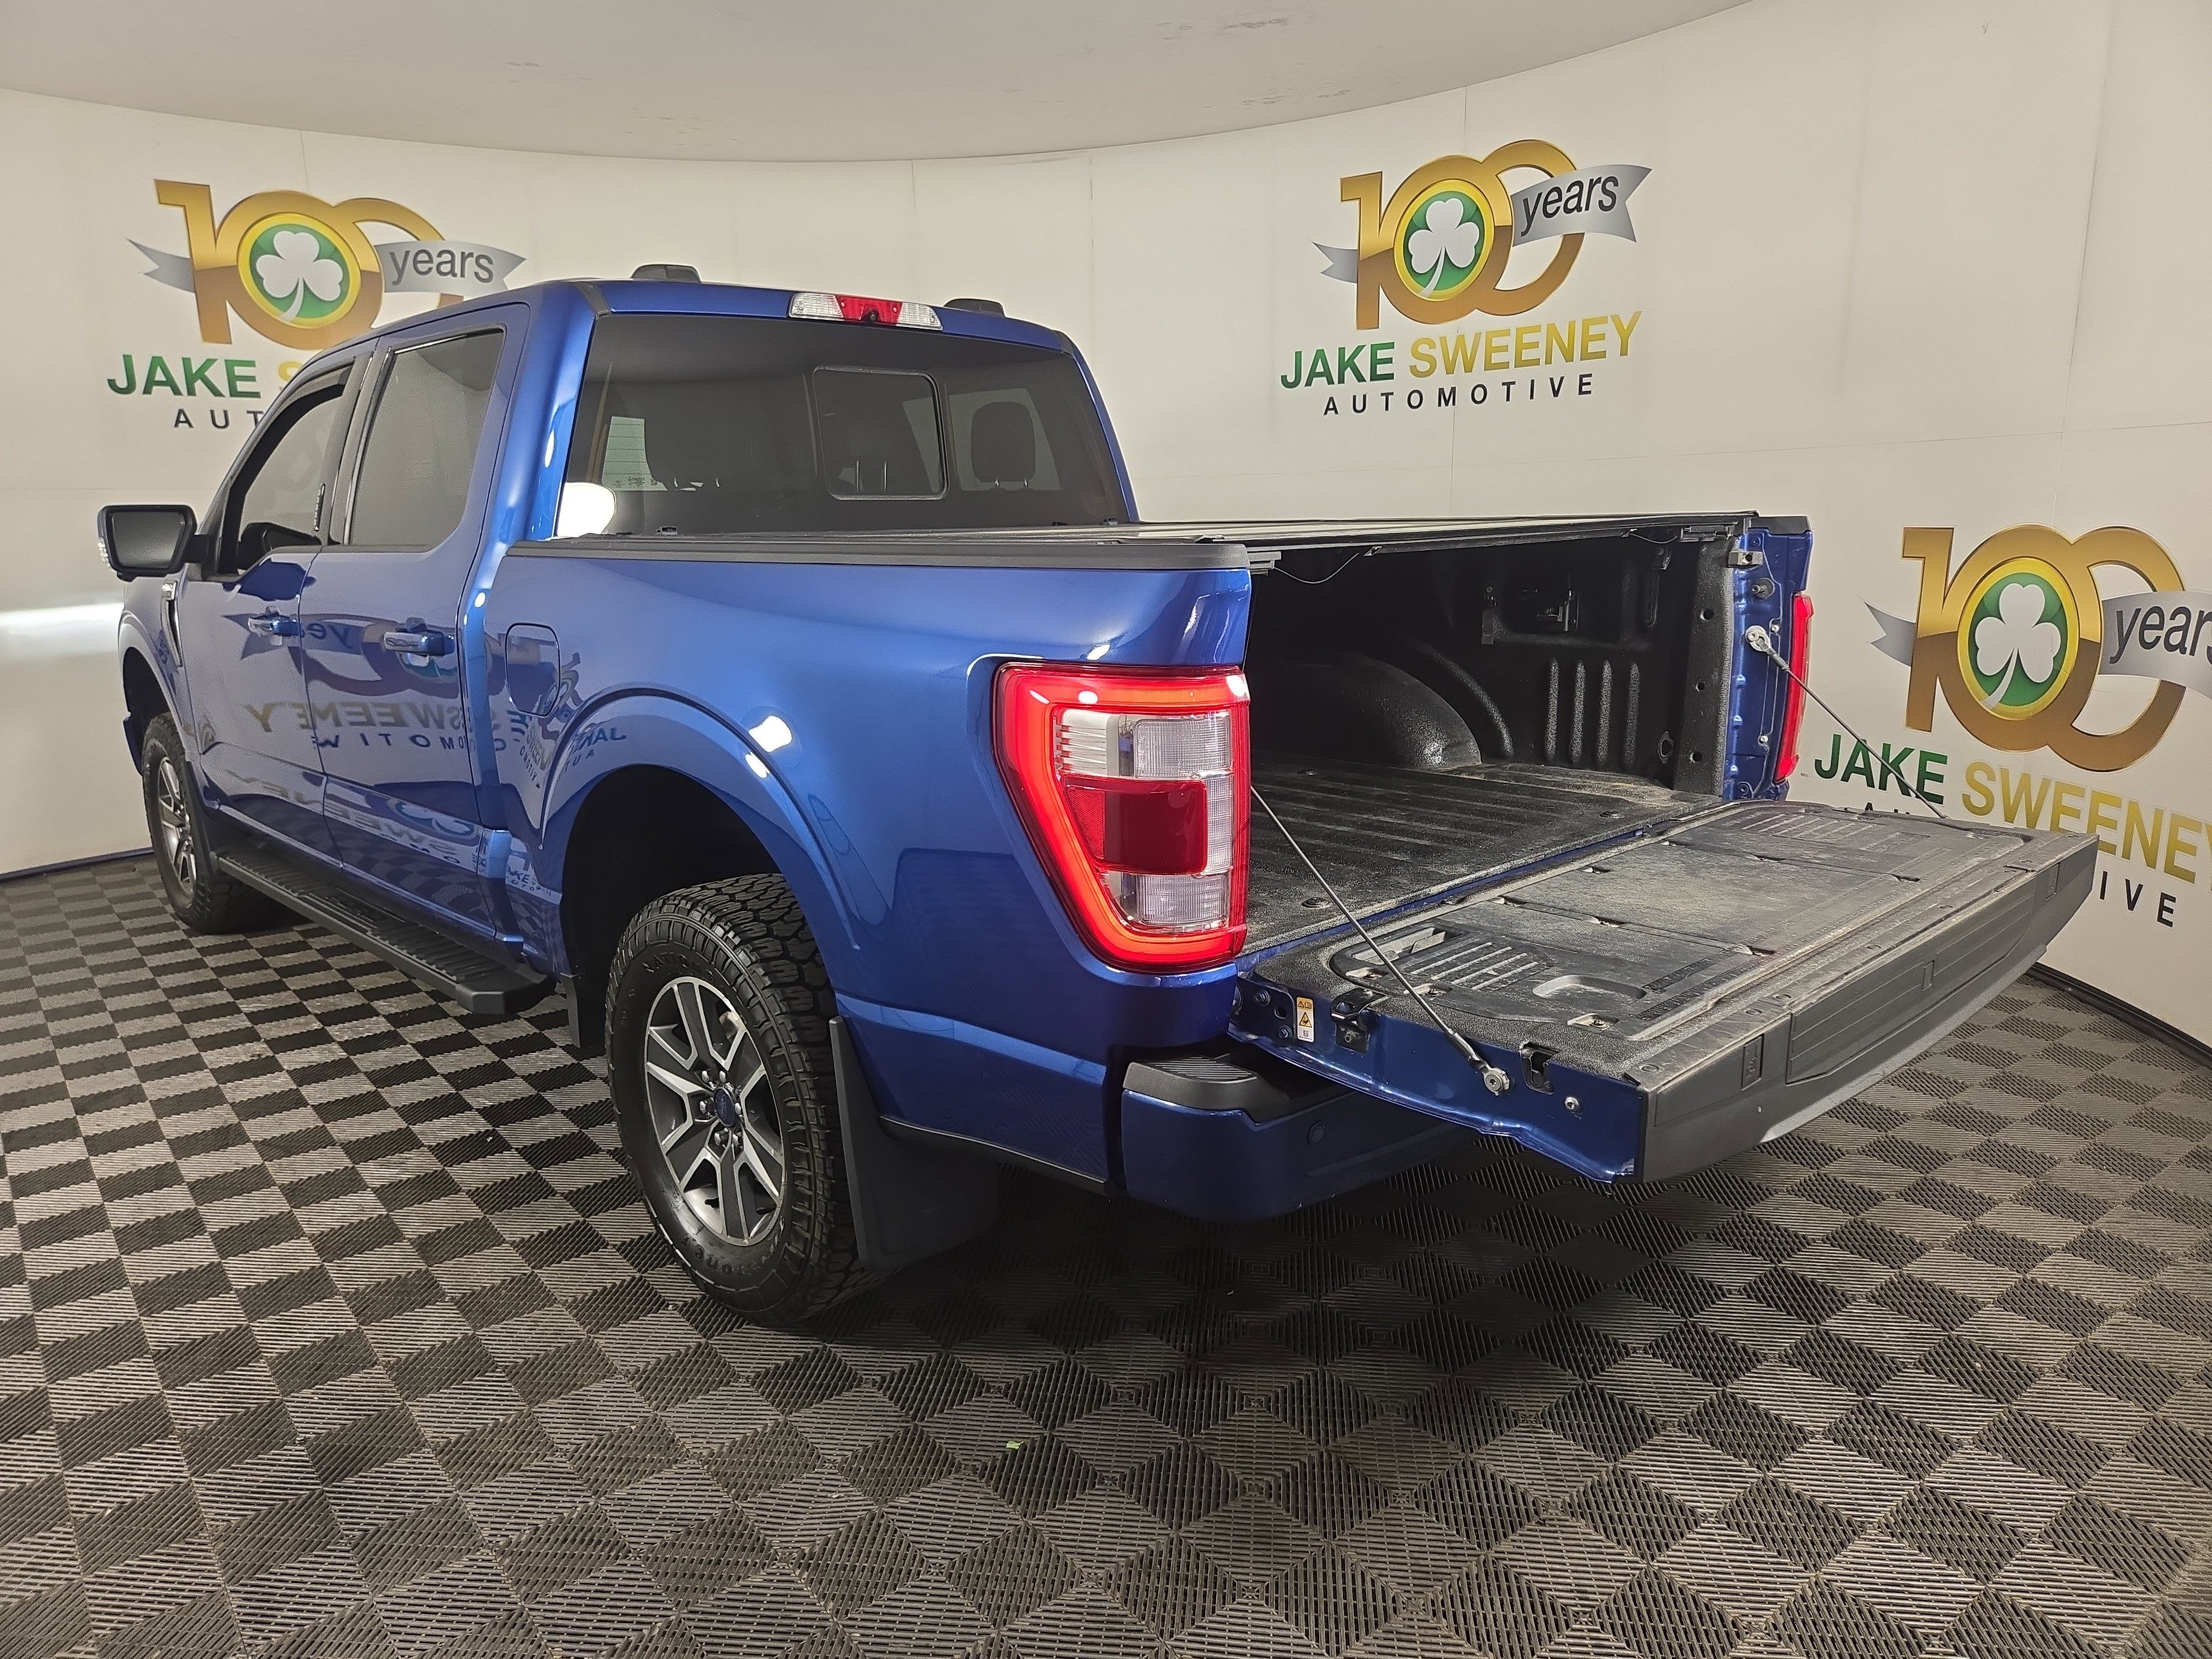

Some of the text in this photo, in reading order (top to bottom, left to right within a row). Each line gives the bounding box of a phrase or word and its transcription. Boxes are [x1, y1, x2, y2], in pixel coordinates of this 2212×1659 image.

[389, 247, 494, 285] years
[1340, 139, 1619, 330] 100 years
[107, 354, 261, 398] JAKE
[1281, 311, 1643, 389] JAKE SWEENEY
[1323, 373, 1593, 416] AUTOMOTIVE
[1902, 524, 2186, 772] 100
[1814, 734, 2212, 891] JAKE SWEENE
